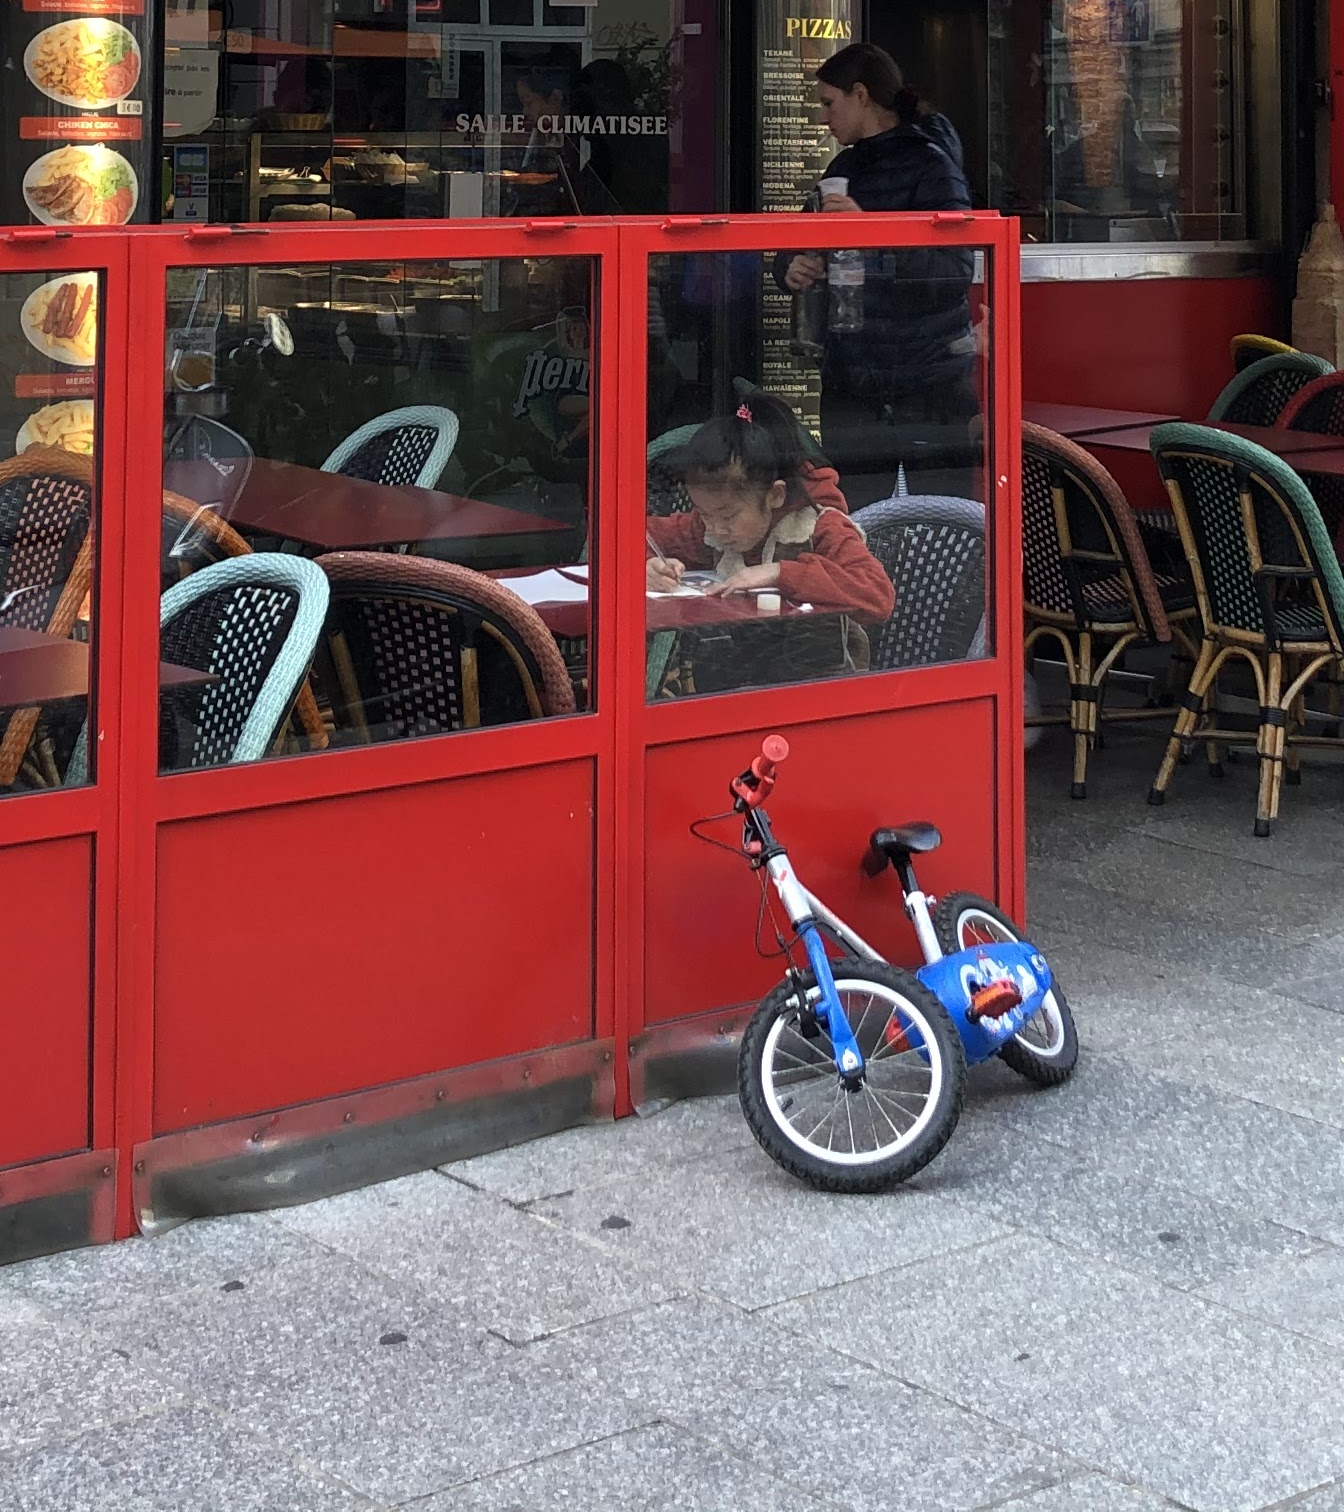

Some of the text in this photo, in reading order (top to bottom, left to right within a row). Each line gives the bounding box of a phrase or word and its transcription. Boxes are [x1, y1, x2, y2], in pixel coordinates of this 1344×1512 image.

[785, 17, 852, 39] PIZZAS
[456, 113, 668, 136] SALLE CLIMATISEE
